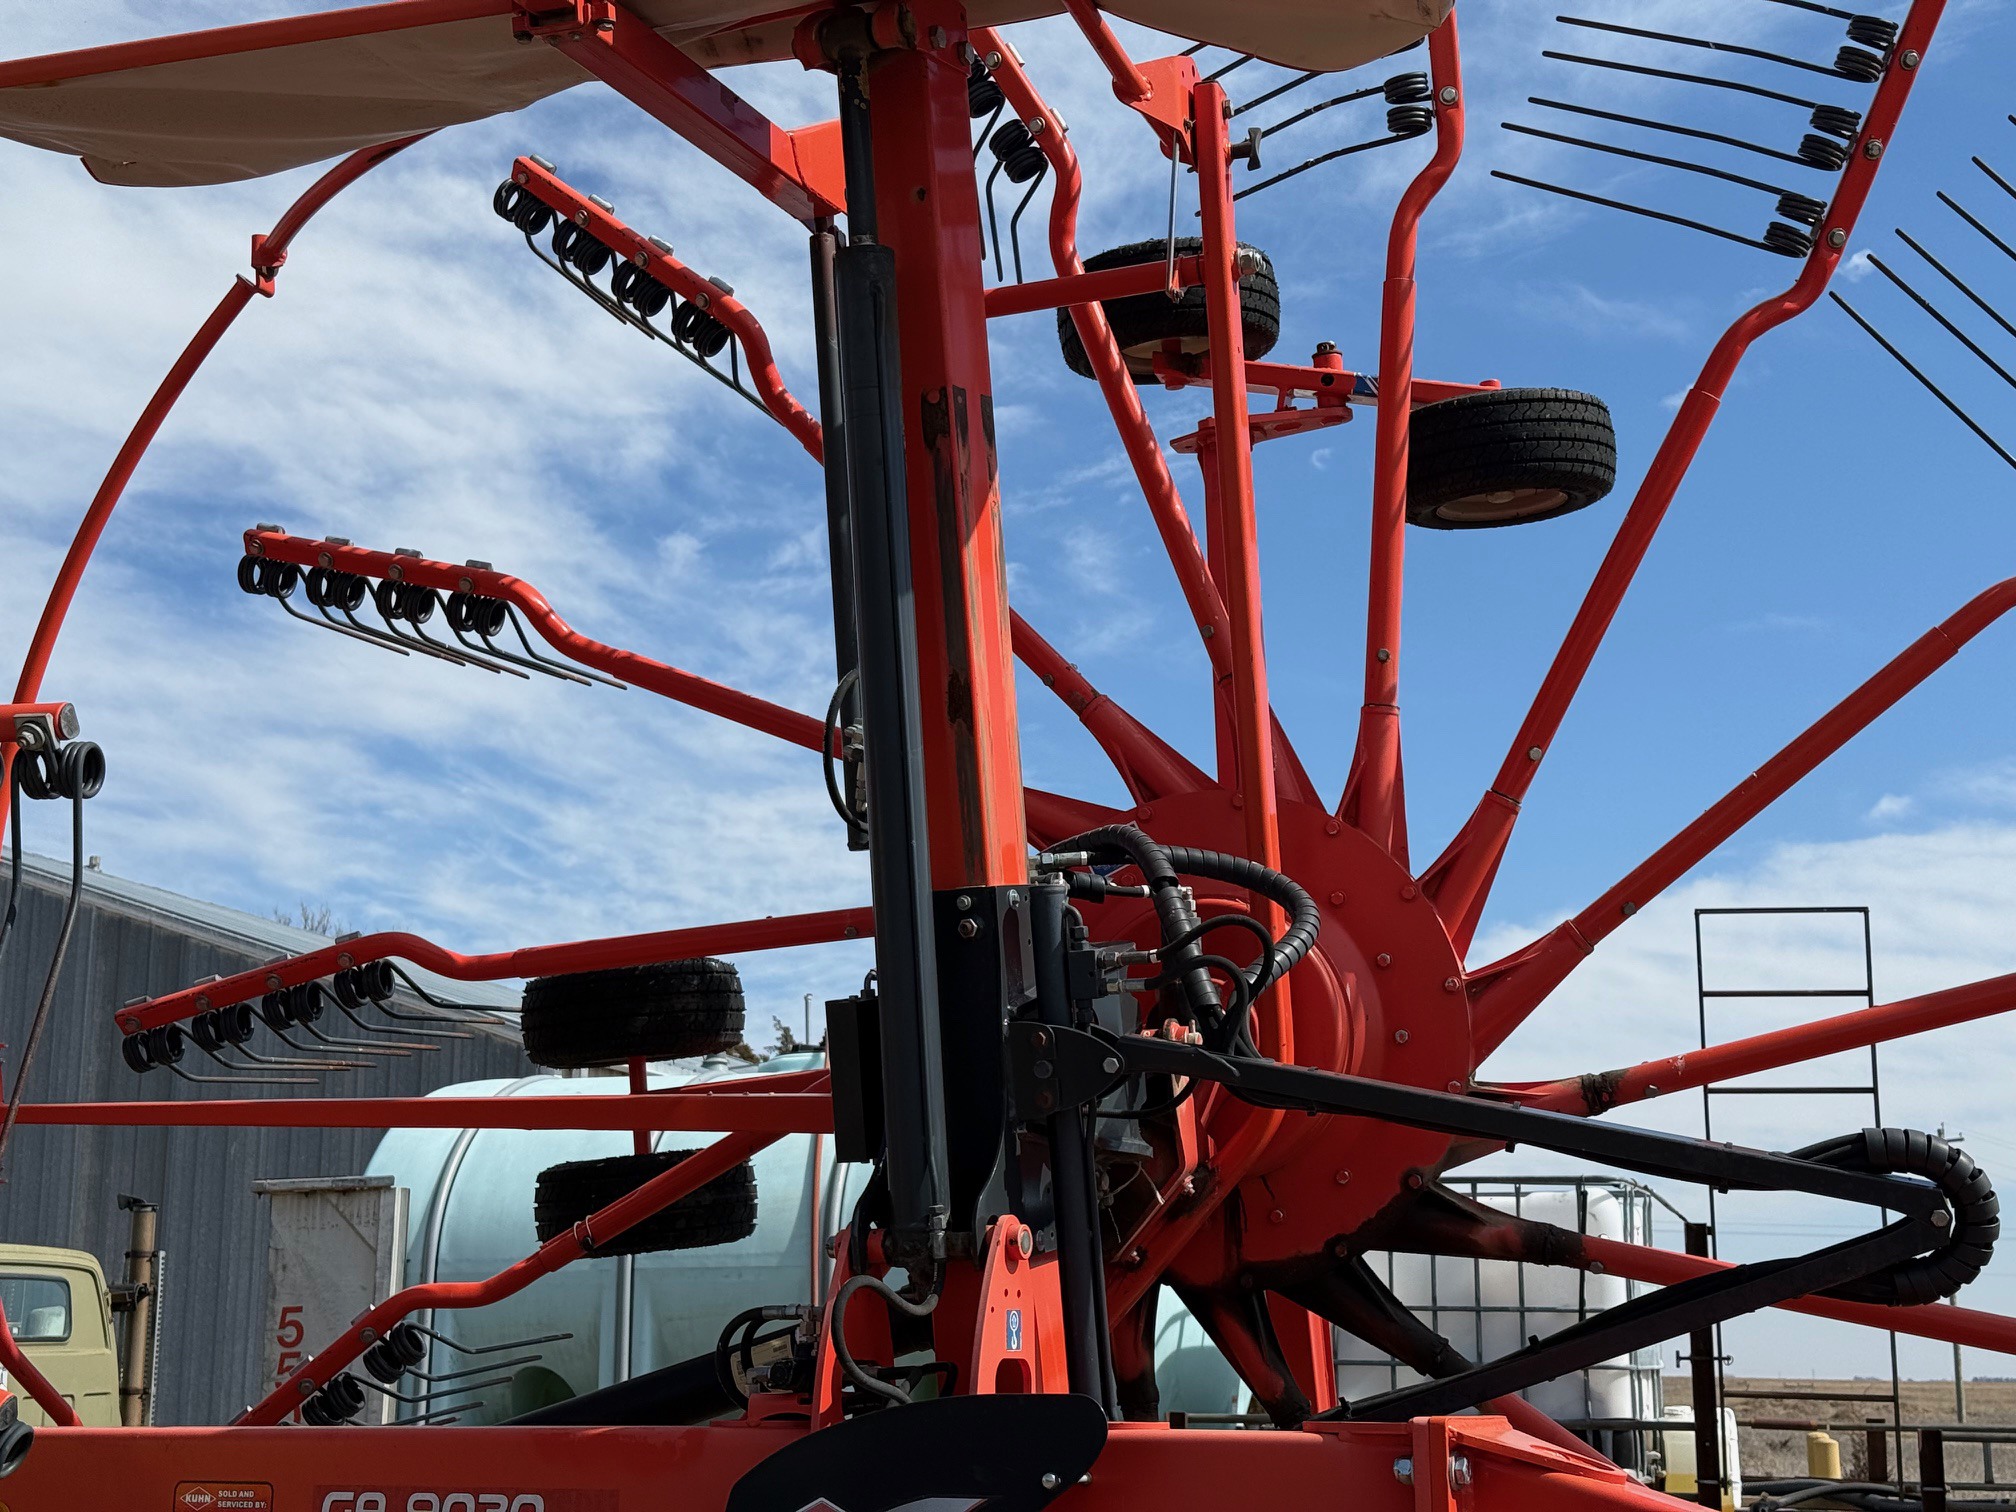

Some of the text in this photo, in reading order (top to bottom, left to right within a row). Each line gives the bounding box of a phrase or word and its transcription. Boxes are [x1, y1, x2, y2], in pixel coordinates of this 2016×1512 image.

[276, 1306, 304, 1348] 5
[185, 1494, 211, 1503] KUHN
[218, 1490, 254, 1498] SOLD AND
[217, 1500, 267, 1509] SERVICED BY:
